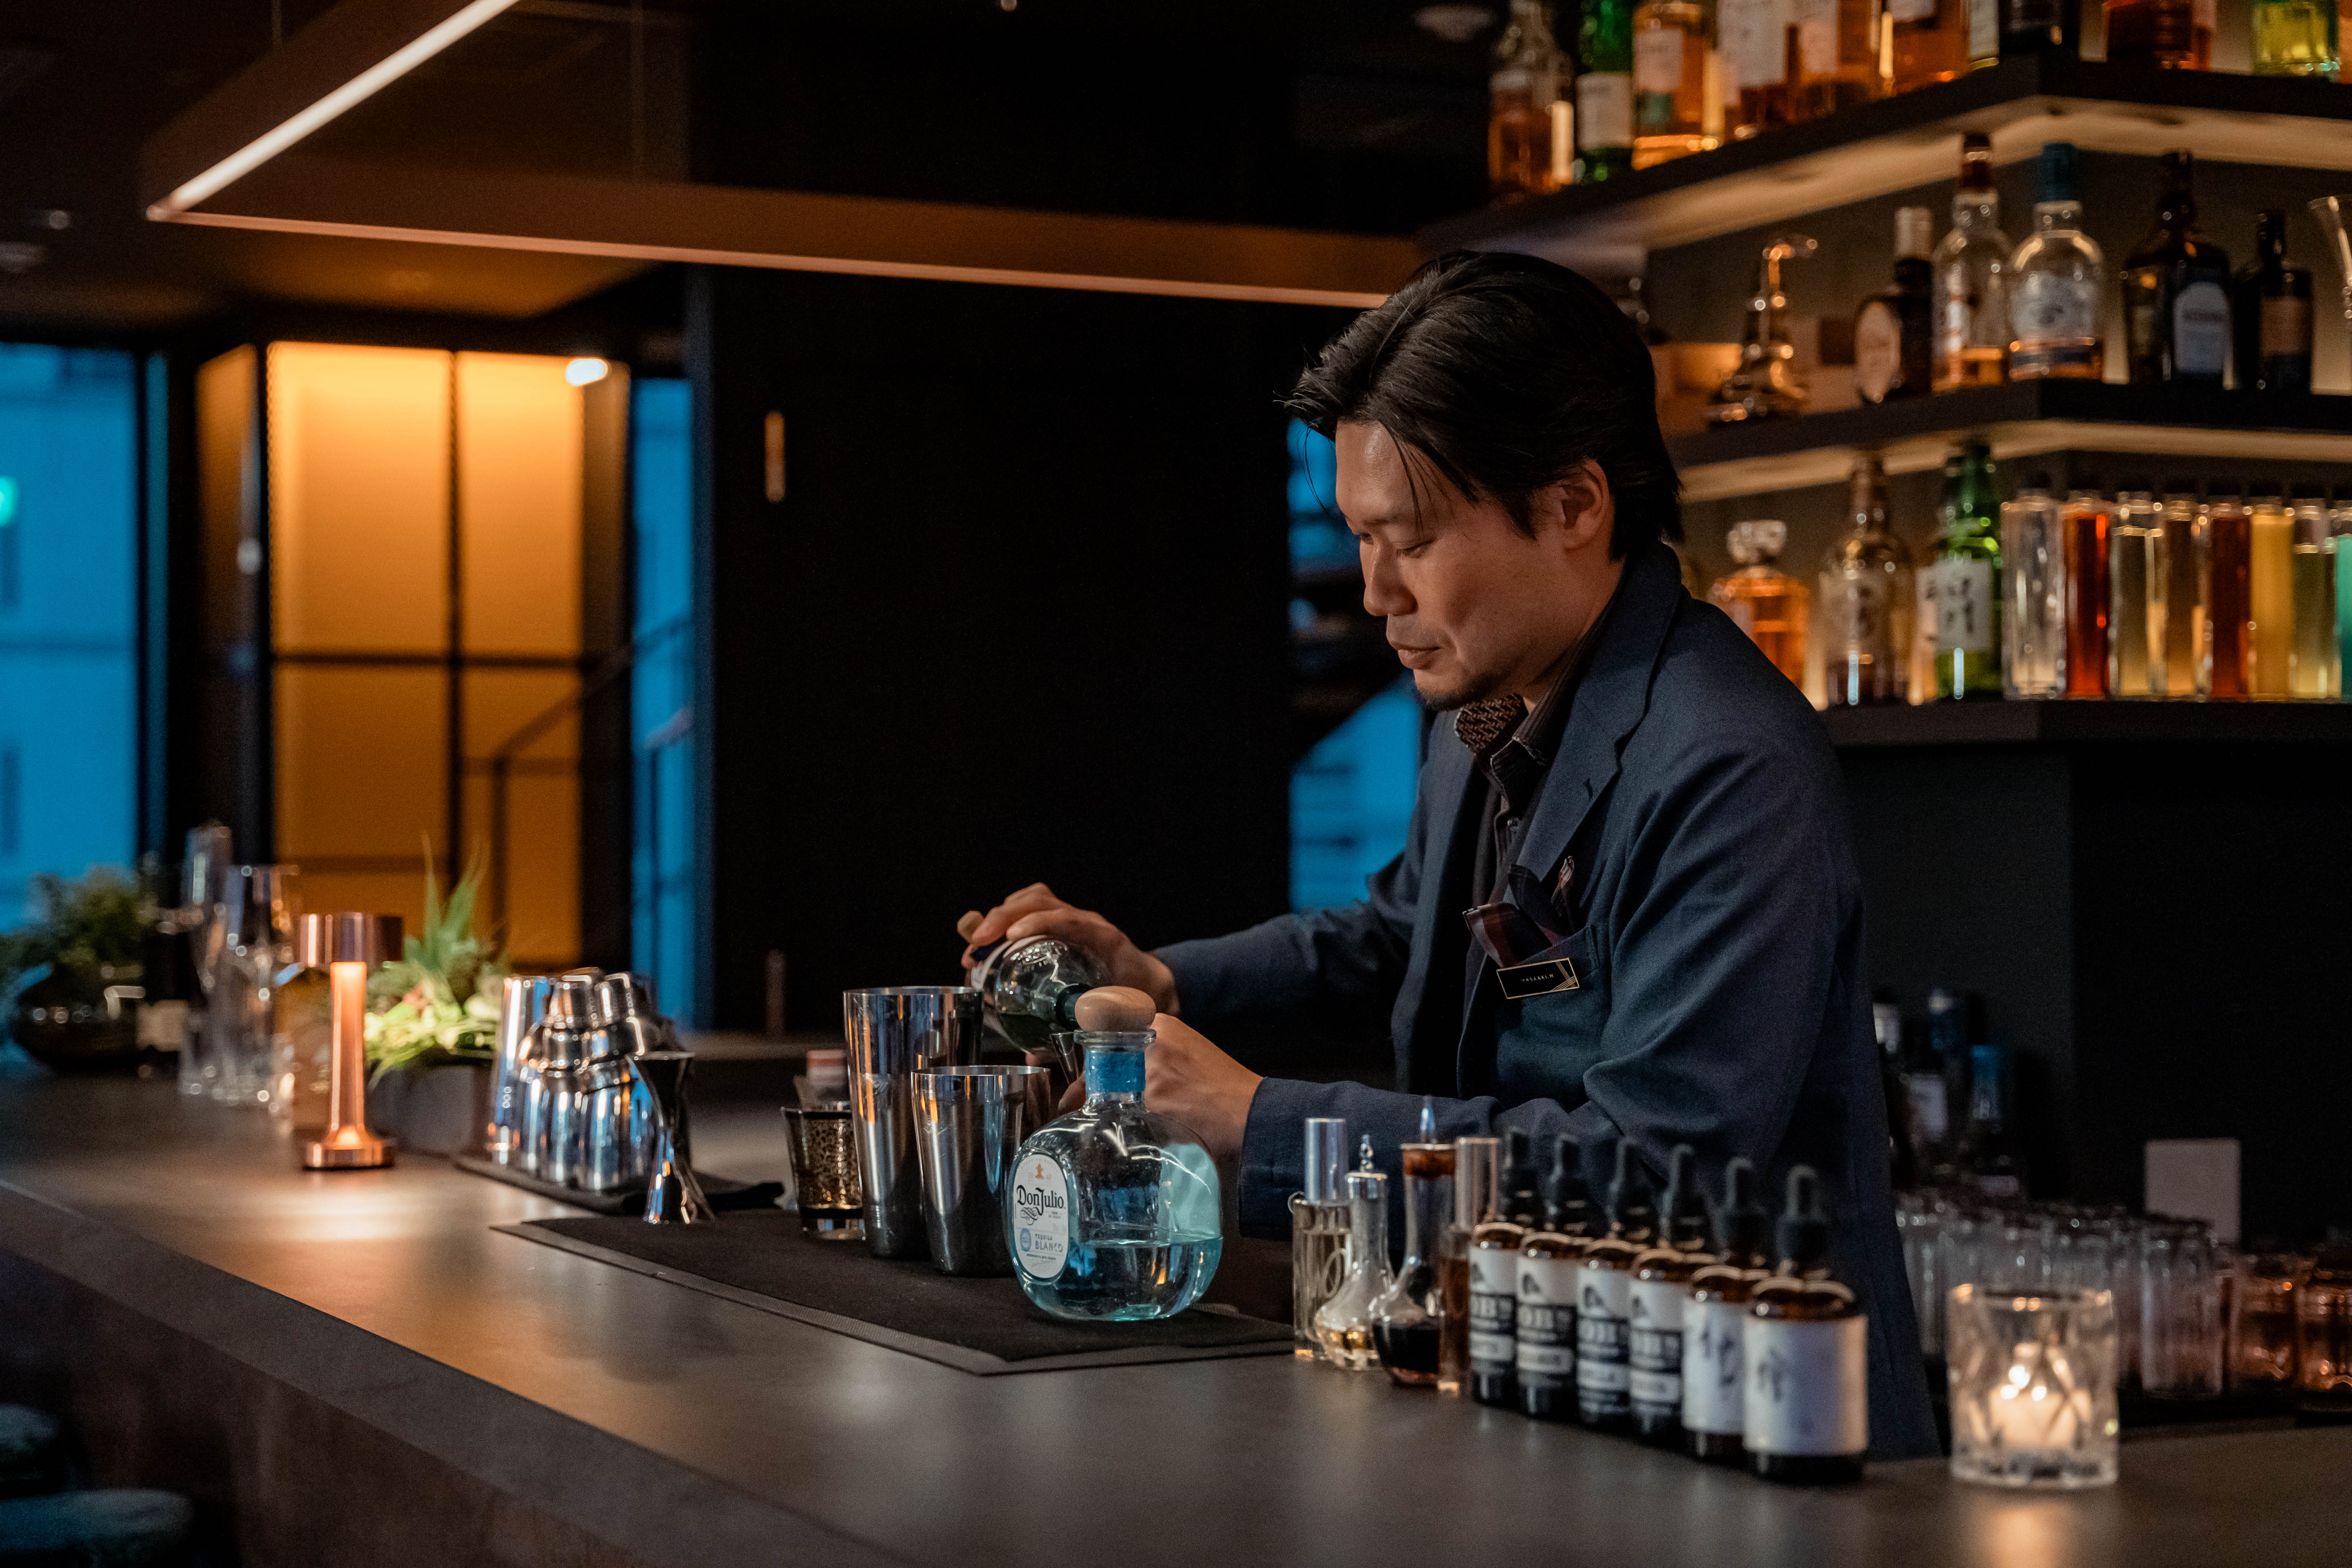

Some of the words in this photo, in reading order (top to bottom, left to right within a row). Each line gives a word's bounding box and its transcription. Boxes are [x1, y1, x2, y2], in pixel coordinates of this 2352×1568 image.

[1017, 1184, 1040, 1205] Don
[1035, 1187, 1064, 1216] Julio
[1035, 1240, 1063, 1253] BLANCO
